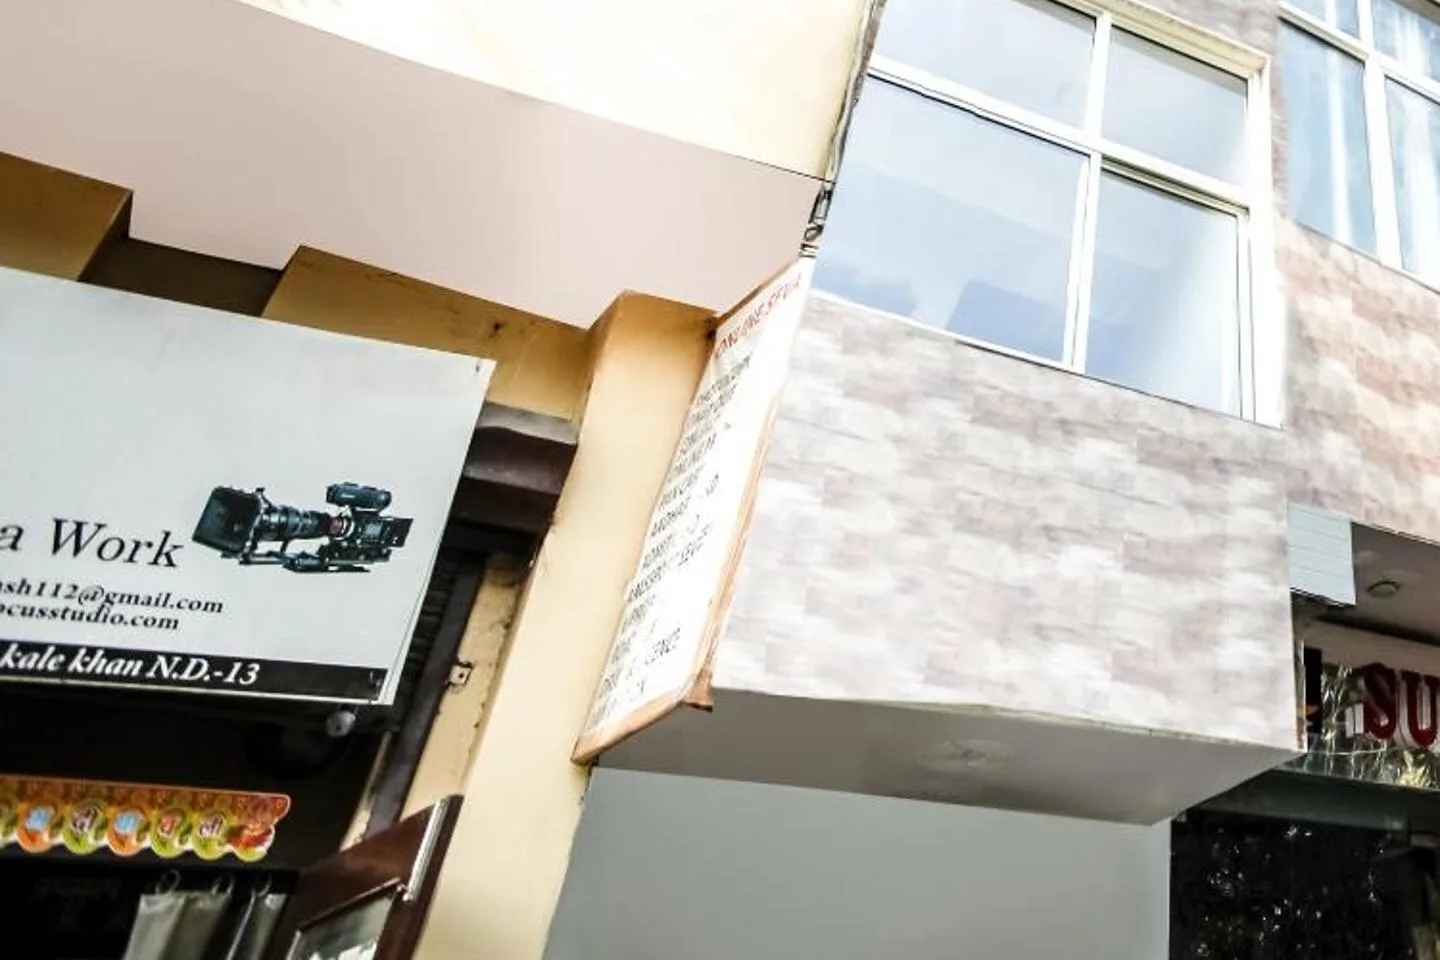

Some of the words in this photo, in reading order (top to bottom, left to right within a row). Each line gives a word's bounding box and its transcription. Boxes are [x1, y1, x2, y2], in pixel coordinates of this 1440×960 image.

[51, 517, 184, 568] Work
[0, 577, 224, 614] sh112@gmail.com
[1, 642, 64, 671] kale
[67, 647, 144, 678] khan
[146, 654, 260, 685] N.D.-13
